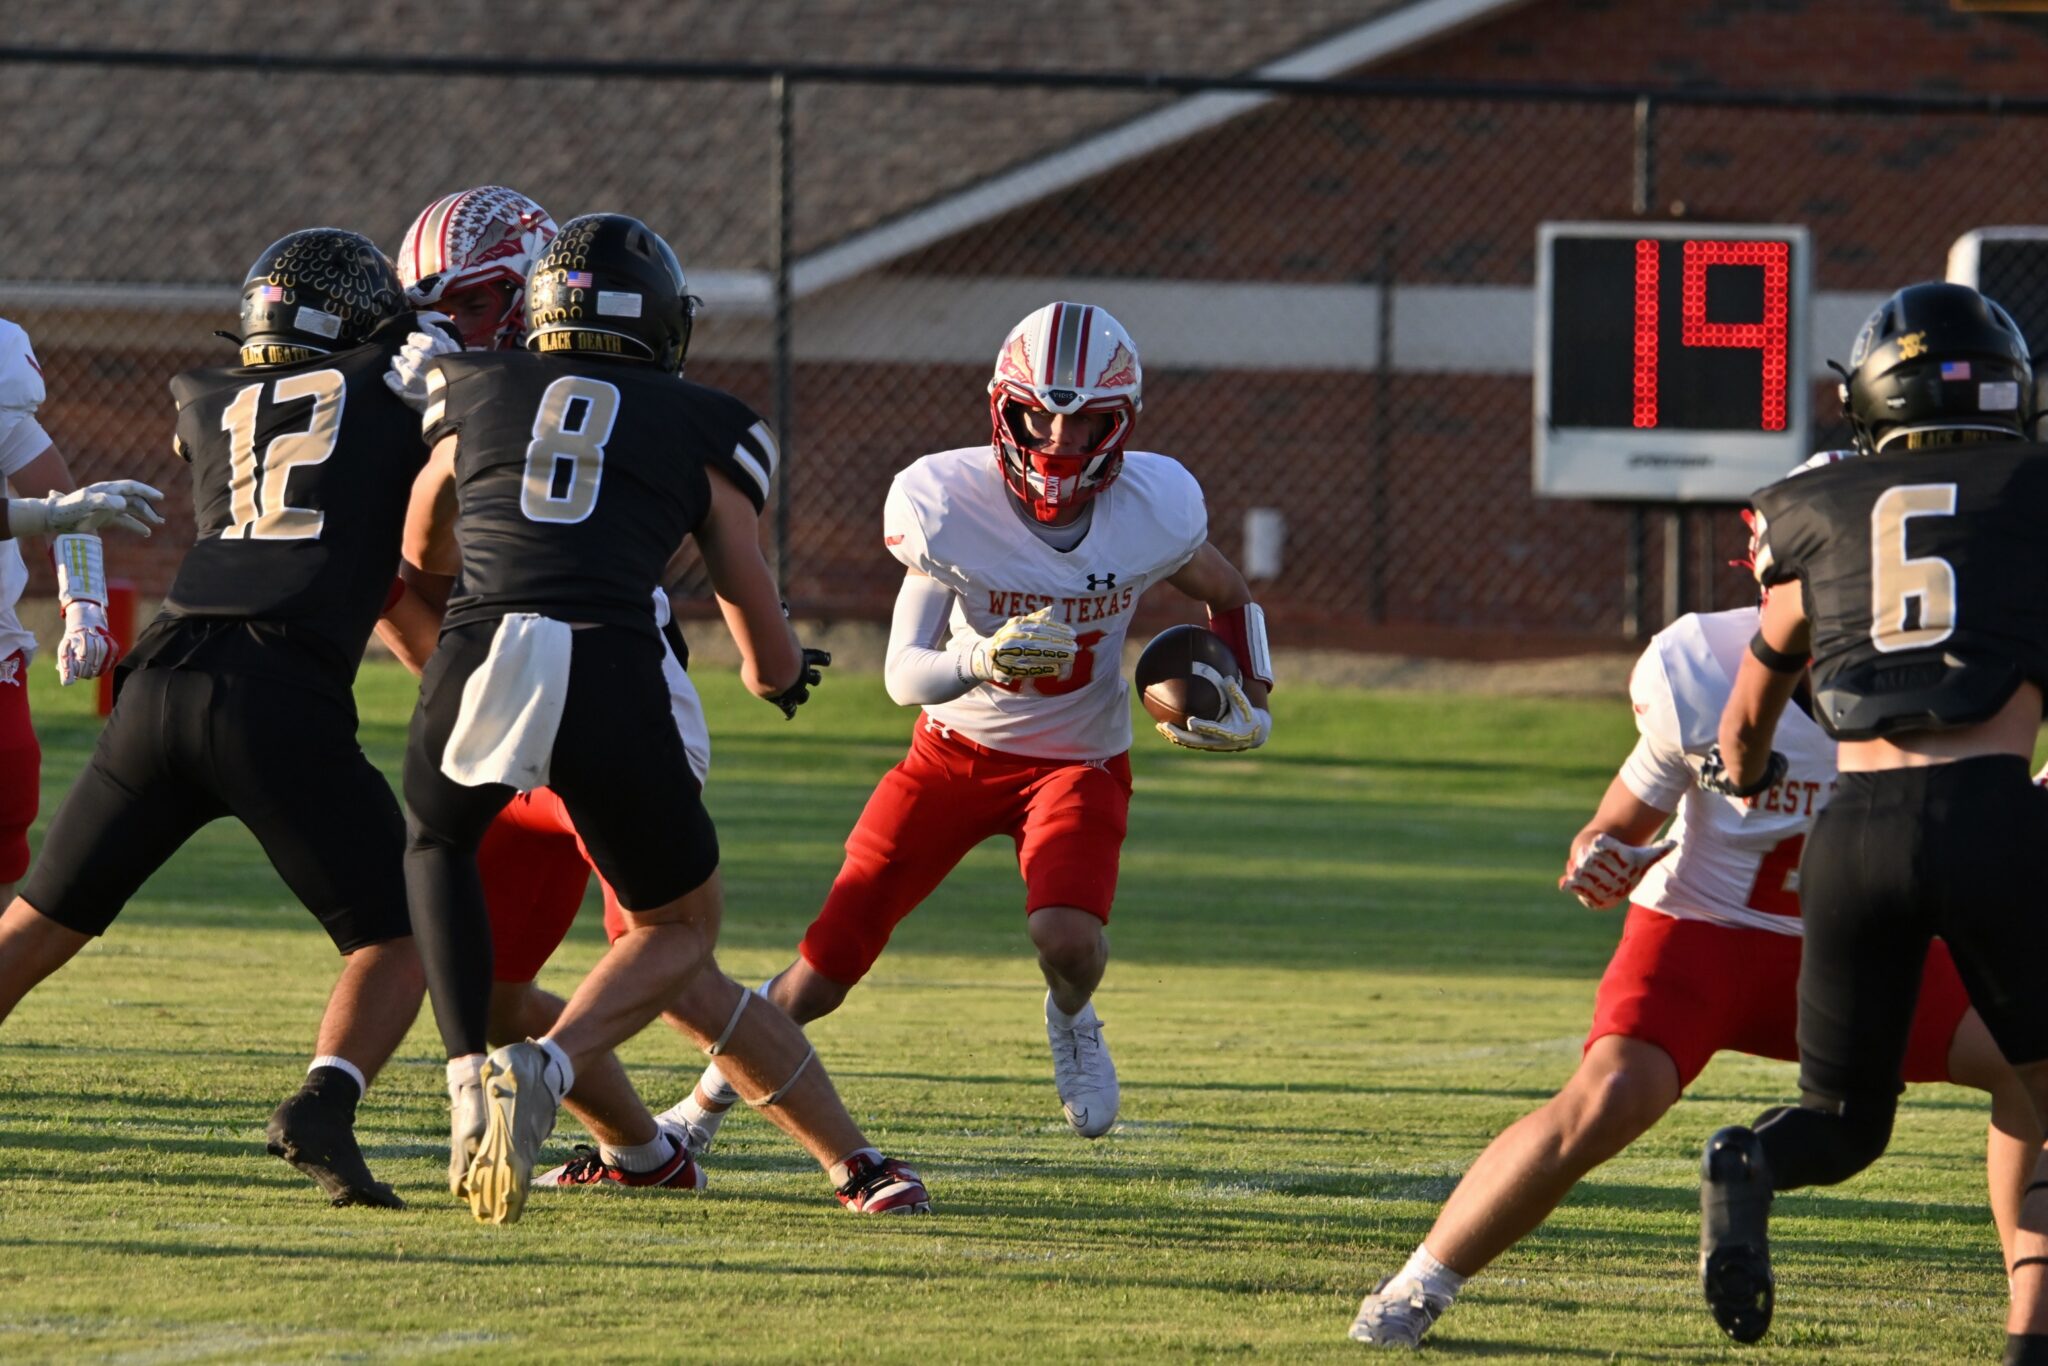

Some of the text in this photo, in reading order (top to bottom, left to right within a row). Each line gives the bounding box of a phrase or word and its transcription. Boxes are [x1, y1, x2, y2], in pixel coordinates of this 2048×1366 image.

[539, 332, 621, 353] BLACK DEATH
[1634, 240, 1789, 430] 19
[220, 368, 347, 540] 12
[520, 375, 621, 525] 8
[1062, 586, 1134, 624] TEXAS
[1869, 483, 1957, 653] 6
